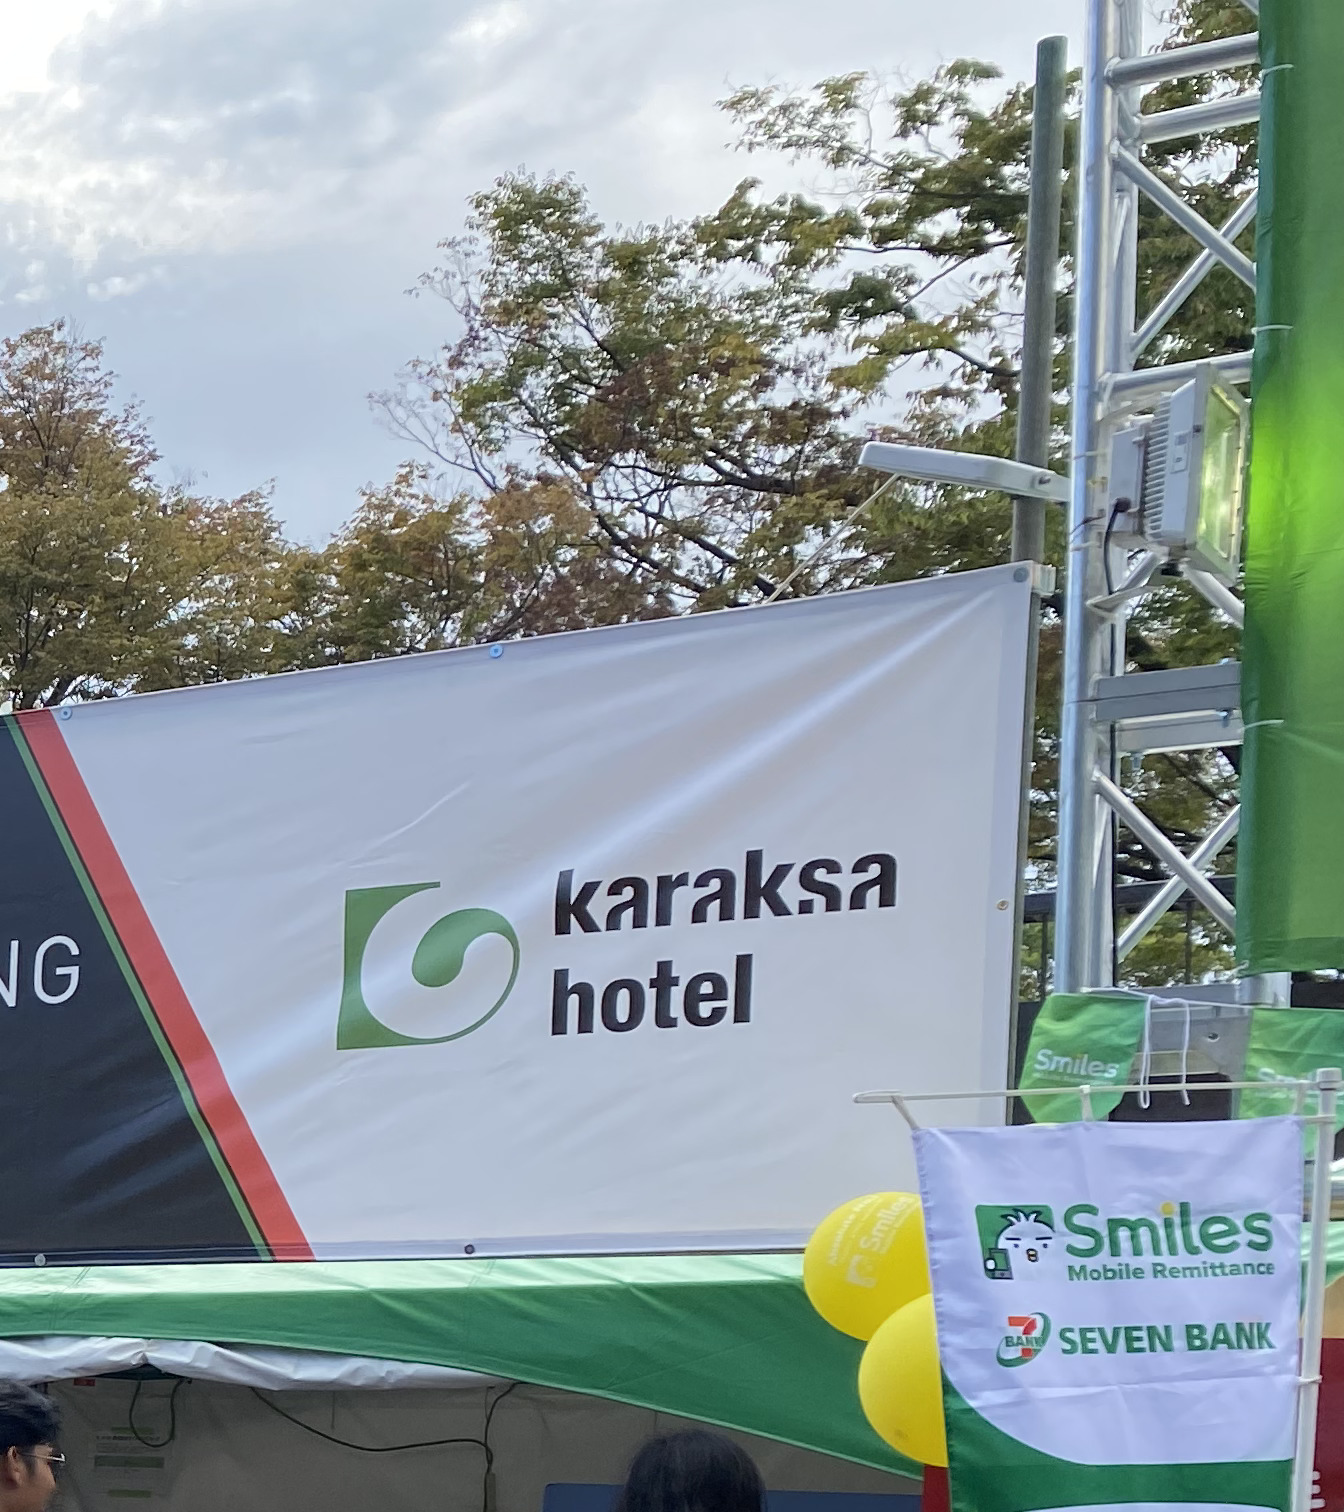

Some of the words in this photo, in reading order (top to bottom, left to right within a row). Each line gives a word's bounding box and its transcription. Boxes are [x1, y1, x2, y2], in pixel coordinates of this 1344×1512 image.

[555, 848, 897, 936] karaksa
[551, 953, 753, 1037] hotel
[1033, 1048, 1120, 1079] Smiles
[1063, 1201, 1273, 1259] Smiles
[1067, 1263, 1145, 1281] Mobile
[1152, 1262, 1274, 1280] Remittance
[1059, 1325, 1174, 1355] SEVEN
[1185, 1322, 1277, 1352] BANK
